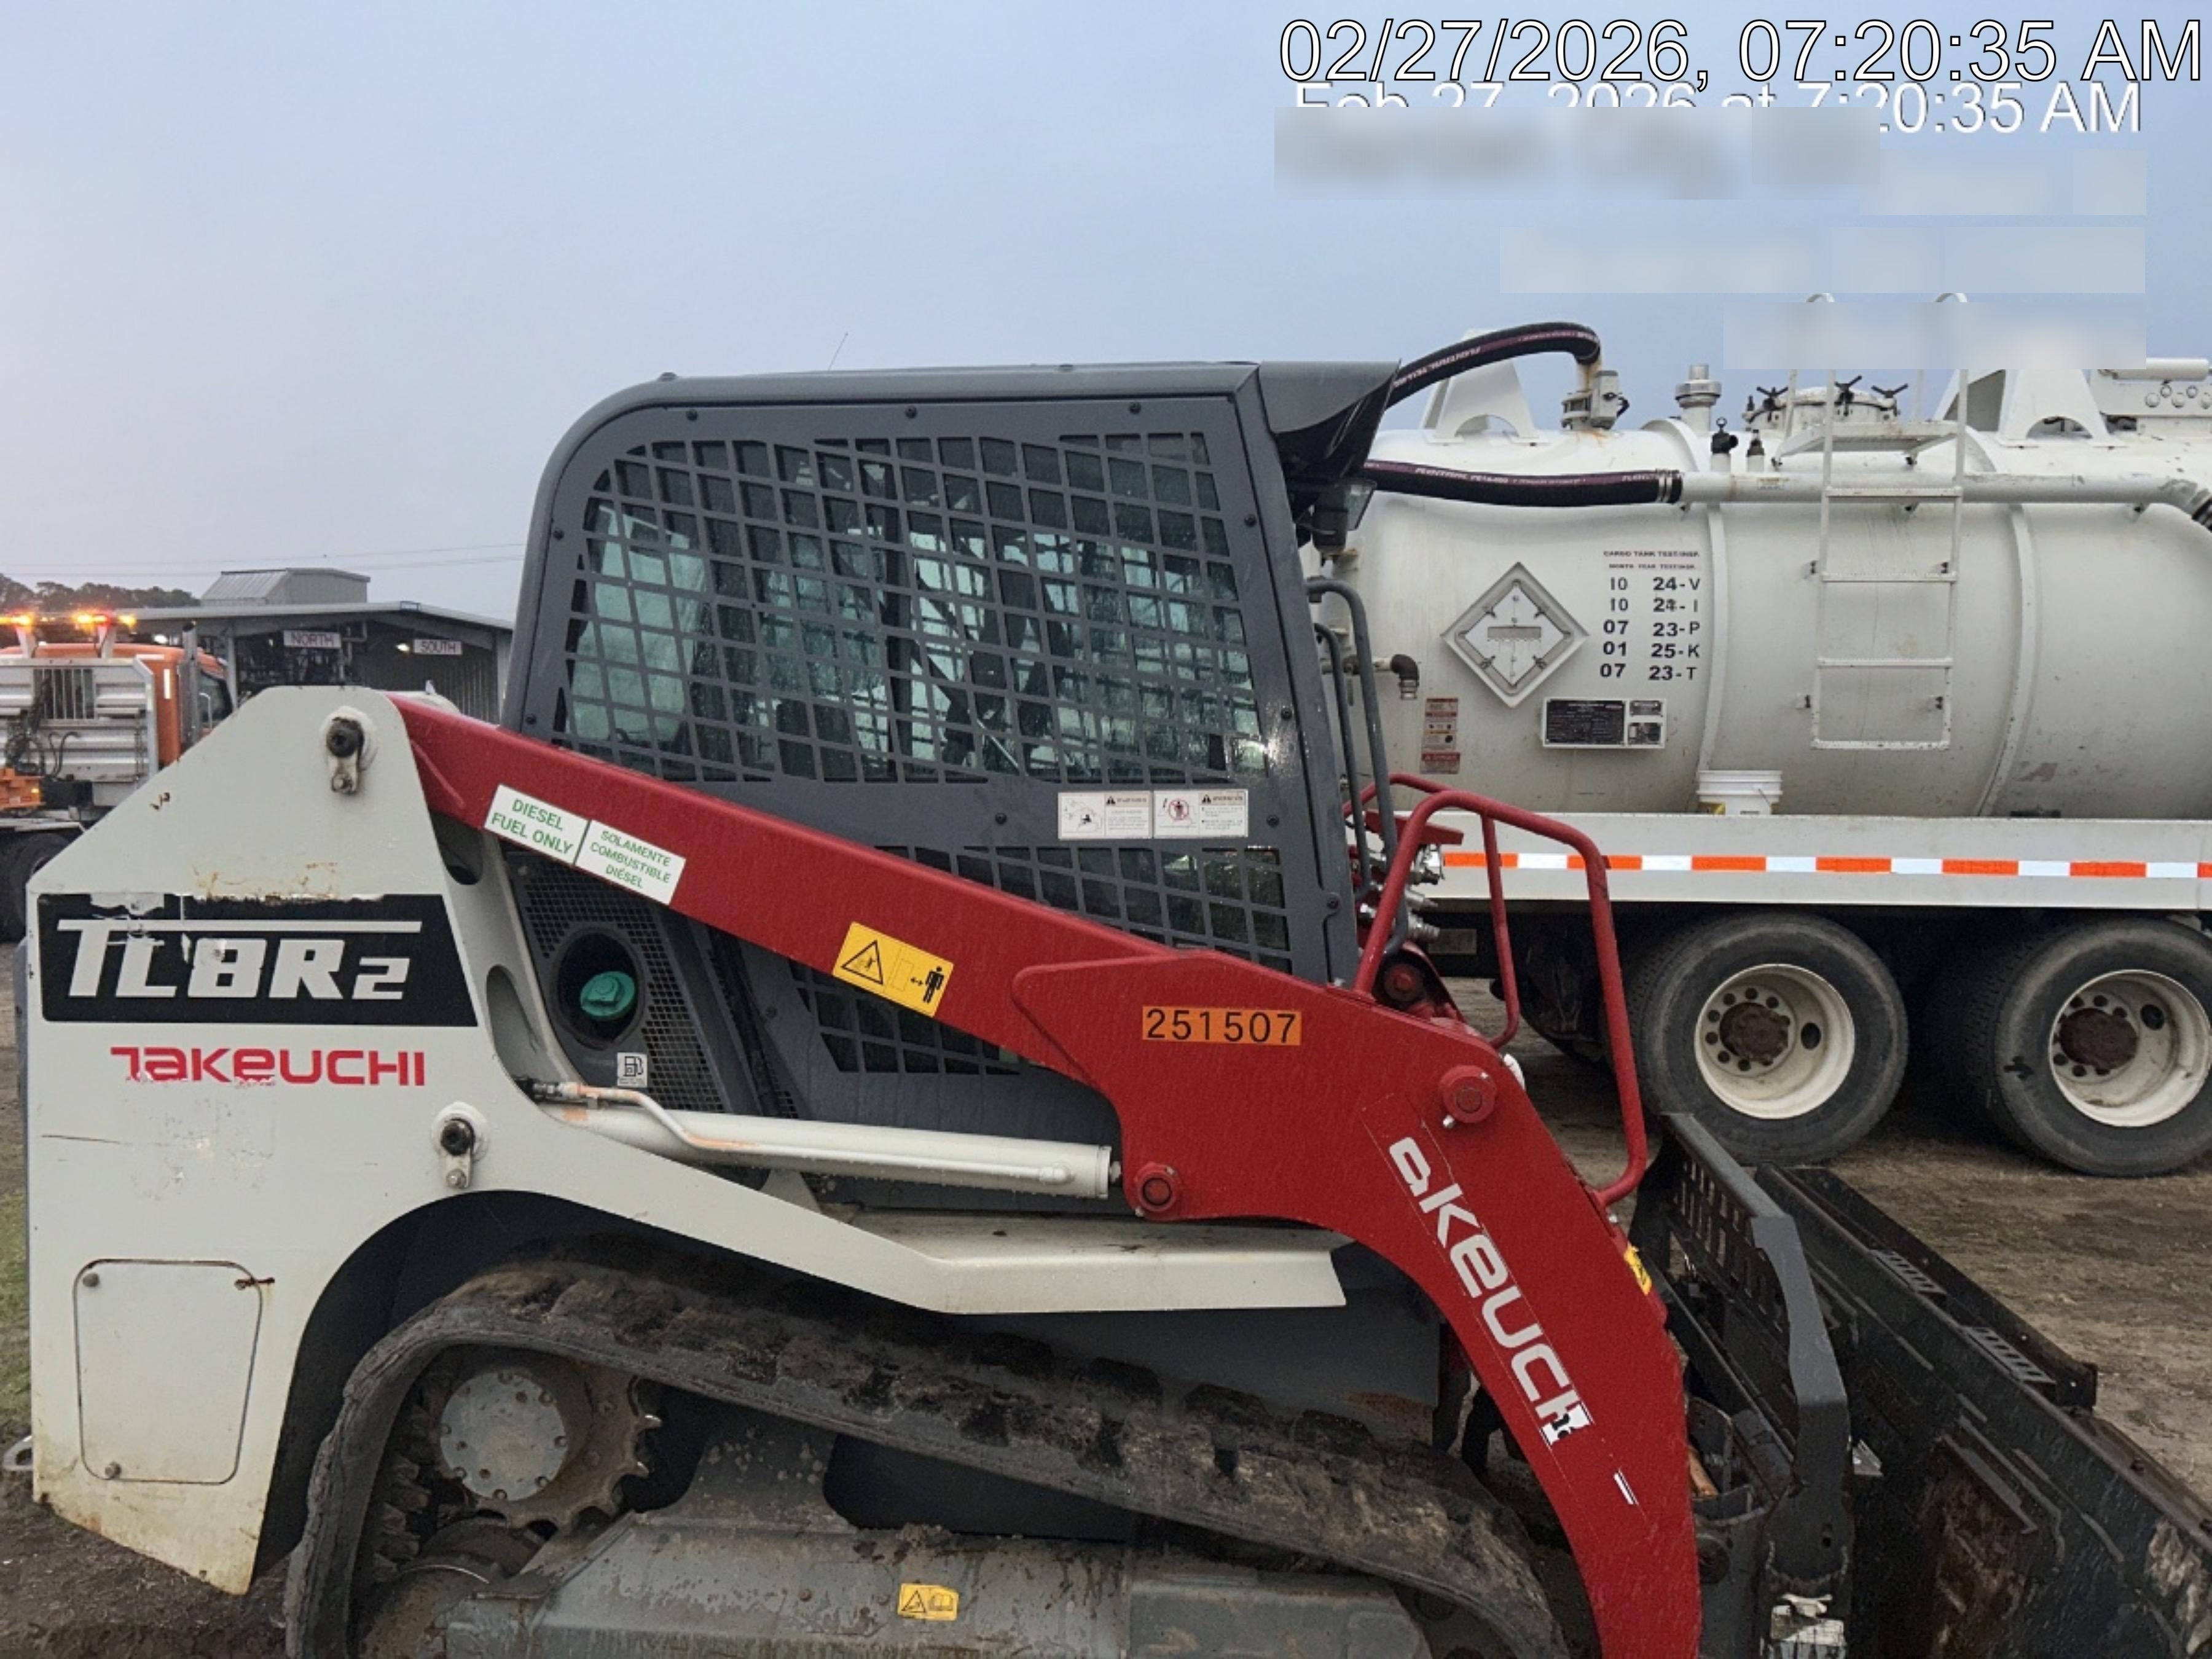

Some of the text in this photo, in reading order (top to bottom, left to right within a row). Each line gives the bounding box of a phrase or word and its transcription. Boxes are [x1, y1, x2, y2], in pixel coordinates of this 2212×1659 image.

[290, 633, 334, 646] NORTH
[1603, 619, 1629, 635] 07
[422, 641, 456, 653] SOUTH
[1603, 641, 1626, 656] 01
[1600, 663, 1626, 678] 07
[512, 799, 563, 831] DIESEL
[492, 812, 574, 854] FUEL ONLY
[600, 830, 671, 867] SOLAMENTE
[590, 842, 671, 884] COMBUSTIBLE
[57, 919, 423, 1000] TL8R2
[1147, 1008, 1296, 1043] 251507
